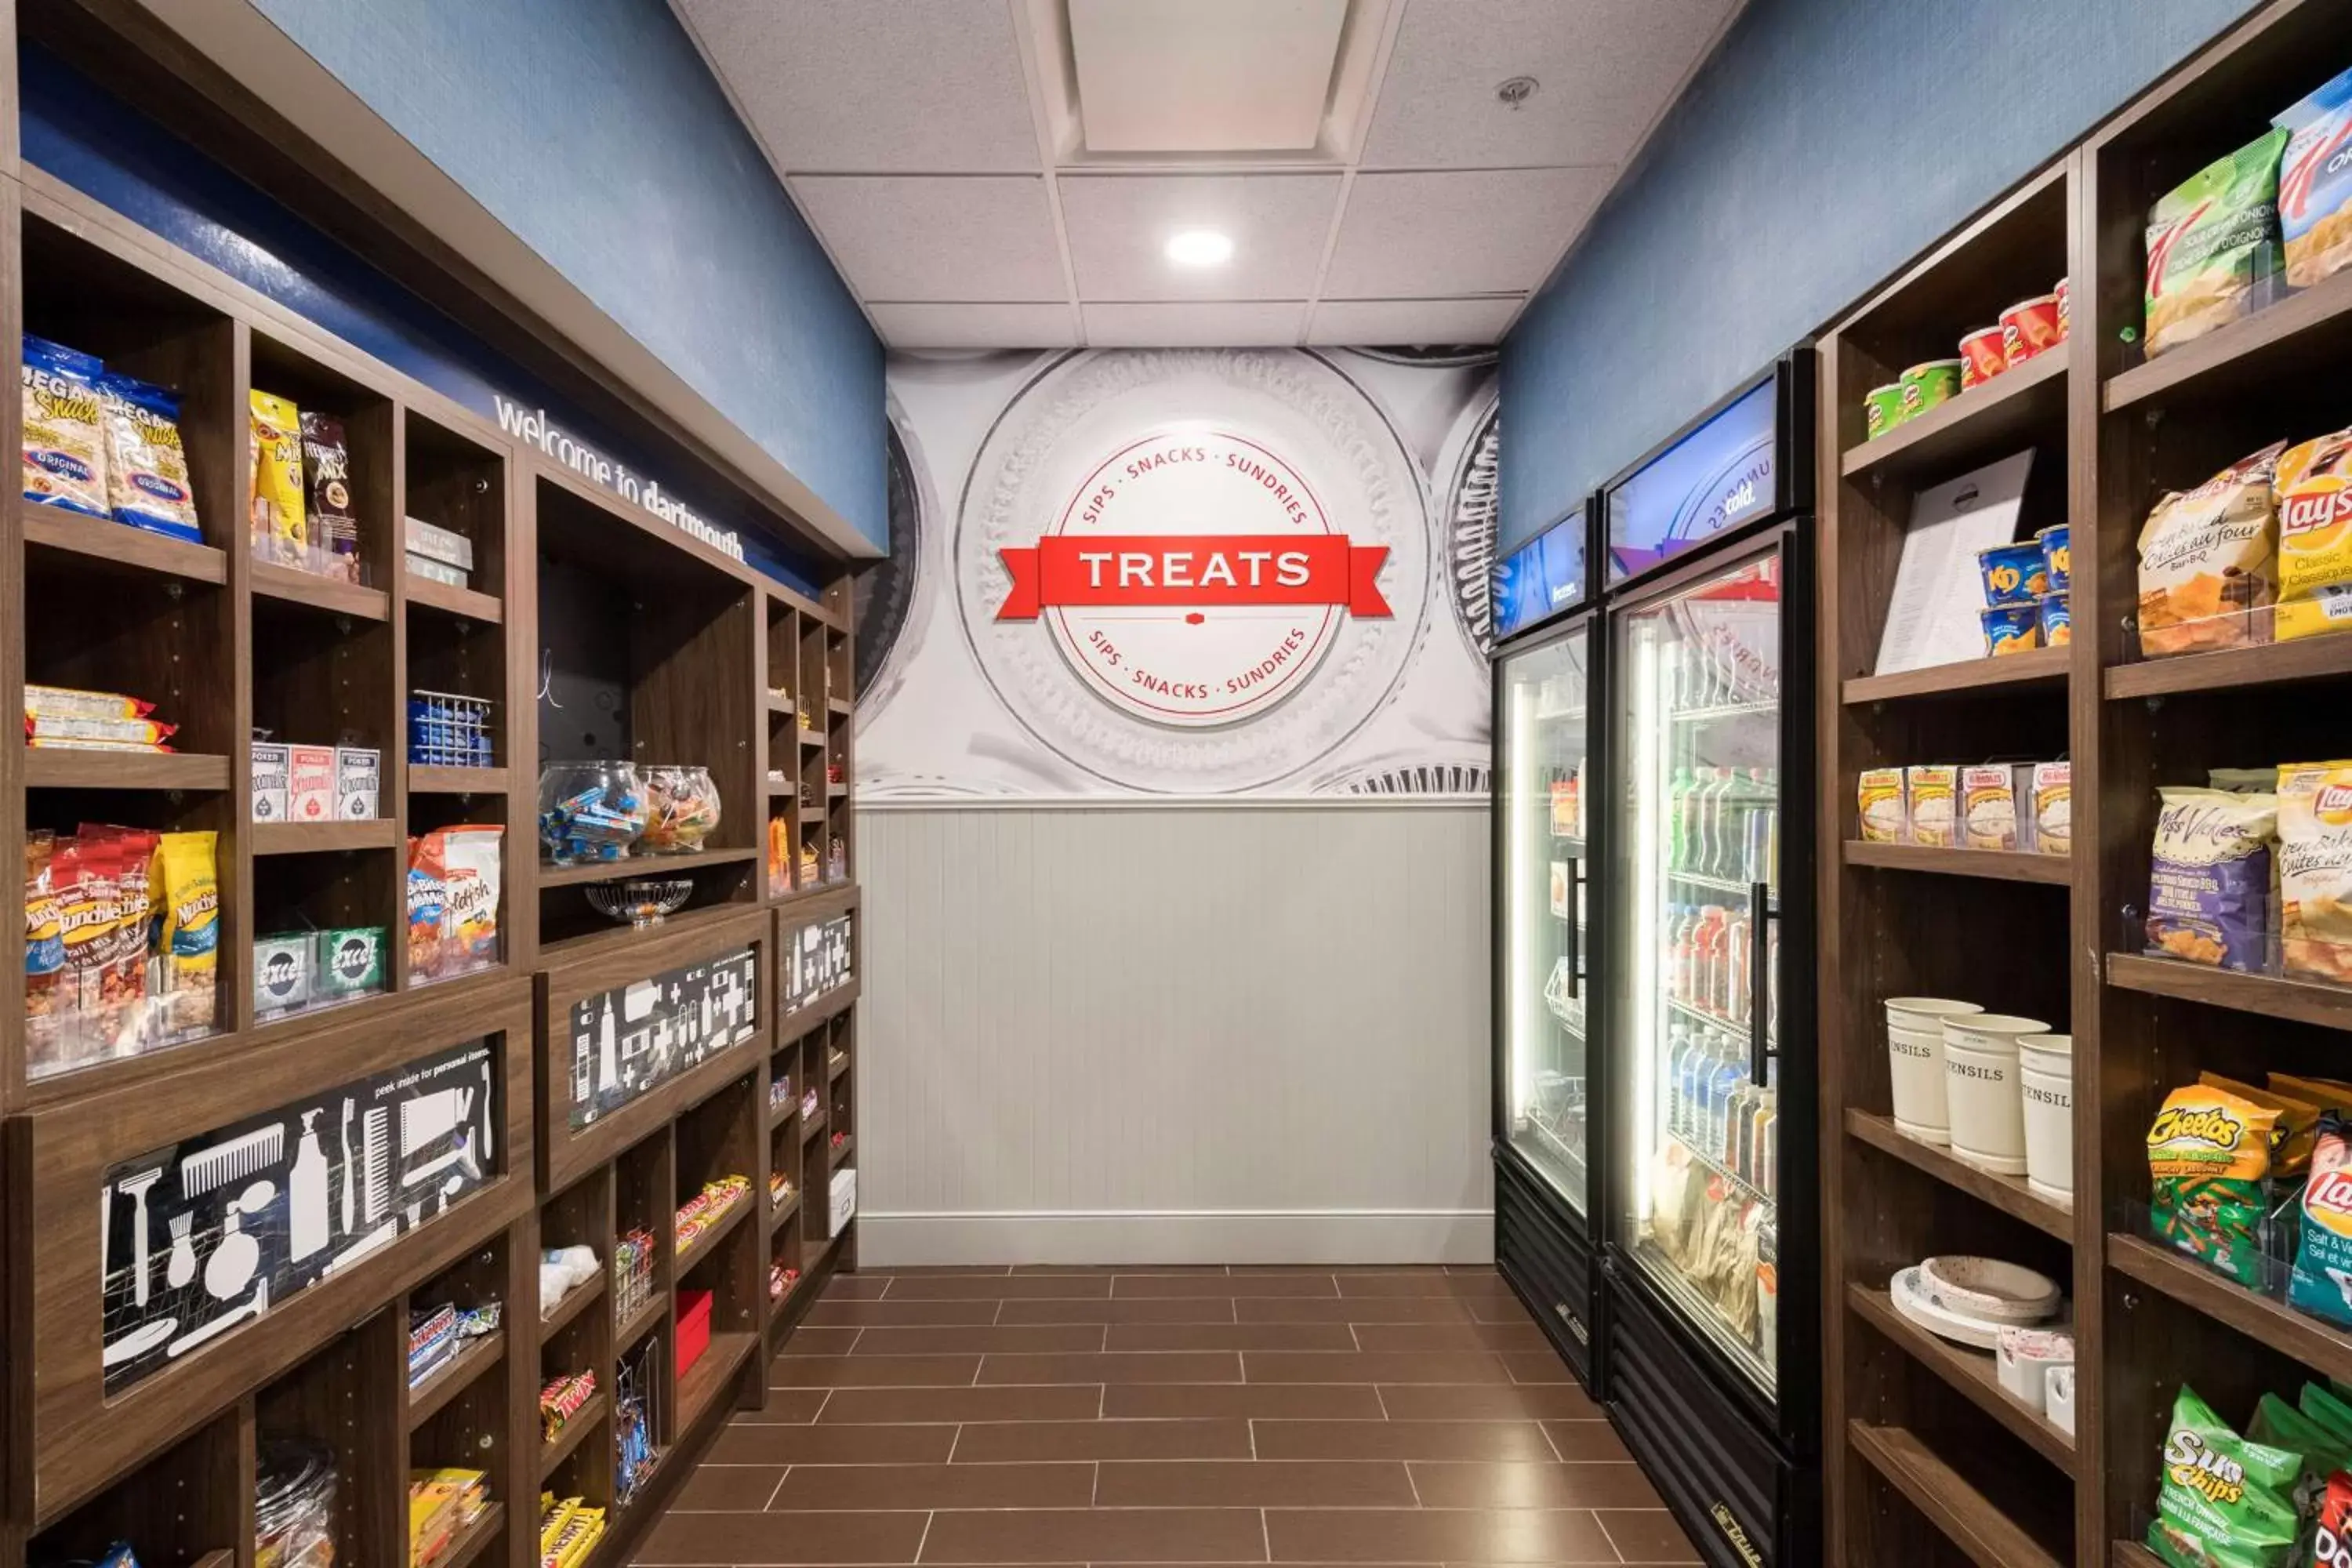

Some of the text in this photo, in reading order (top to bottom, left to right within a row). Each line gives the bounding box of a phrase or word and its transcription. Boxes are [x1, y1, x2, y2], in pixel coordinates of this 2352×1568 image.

[615, 464, 641, 504] to
[1082, 447, 1308, 525] SIPS SNACKS SUNDRIES
[1726, 480, 1756, 515] cold.
[2214, 523, 2260, 552] four
[1079, 550, 1311, 588] TREATS
[2295, 551, 2340, 571] Classic
[1089, 627, 1306, 699] SIPS SNACKS SUNDRIES
[375, 1081, 396, 1100] peek
[421, 1069, 432, 1080] for
[434, 1053, 466, 1078] personal
[1946, 1060, 2004, 1081] TENSILS
[2147, 1107, 2240, 1148] Cheetos
[2308, 1229, 2328, 1247] Salt
[2331, 1235, 2339, 1249] &
[2309, 1245, 2325, 1260] Sel
[2328, 1252, 2339, 1262] et
[2165, 1429, 2245, 1484] Sun
[2169, 1465, 2243, 1504] Chips
